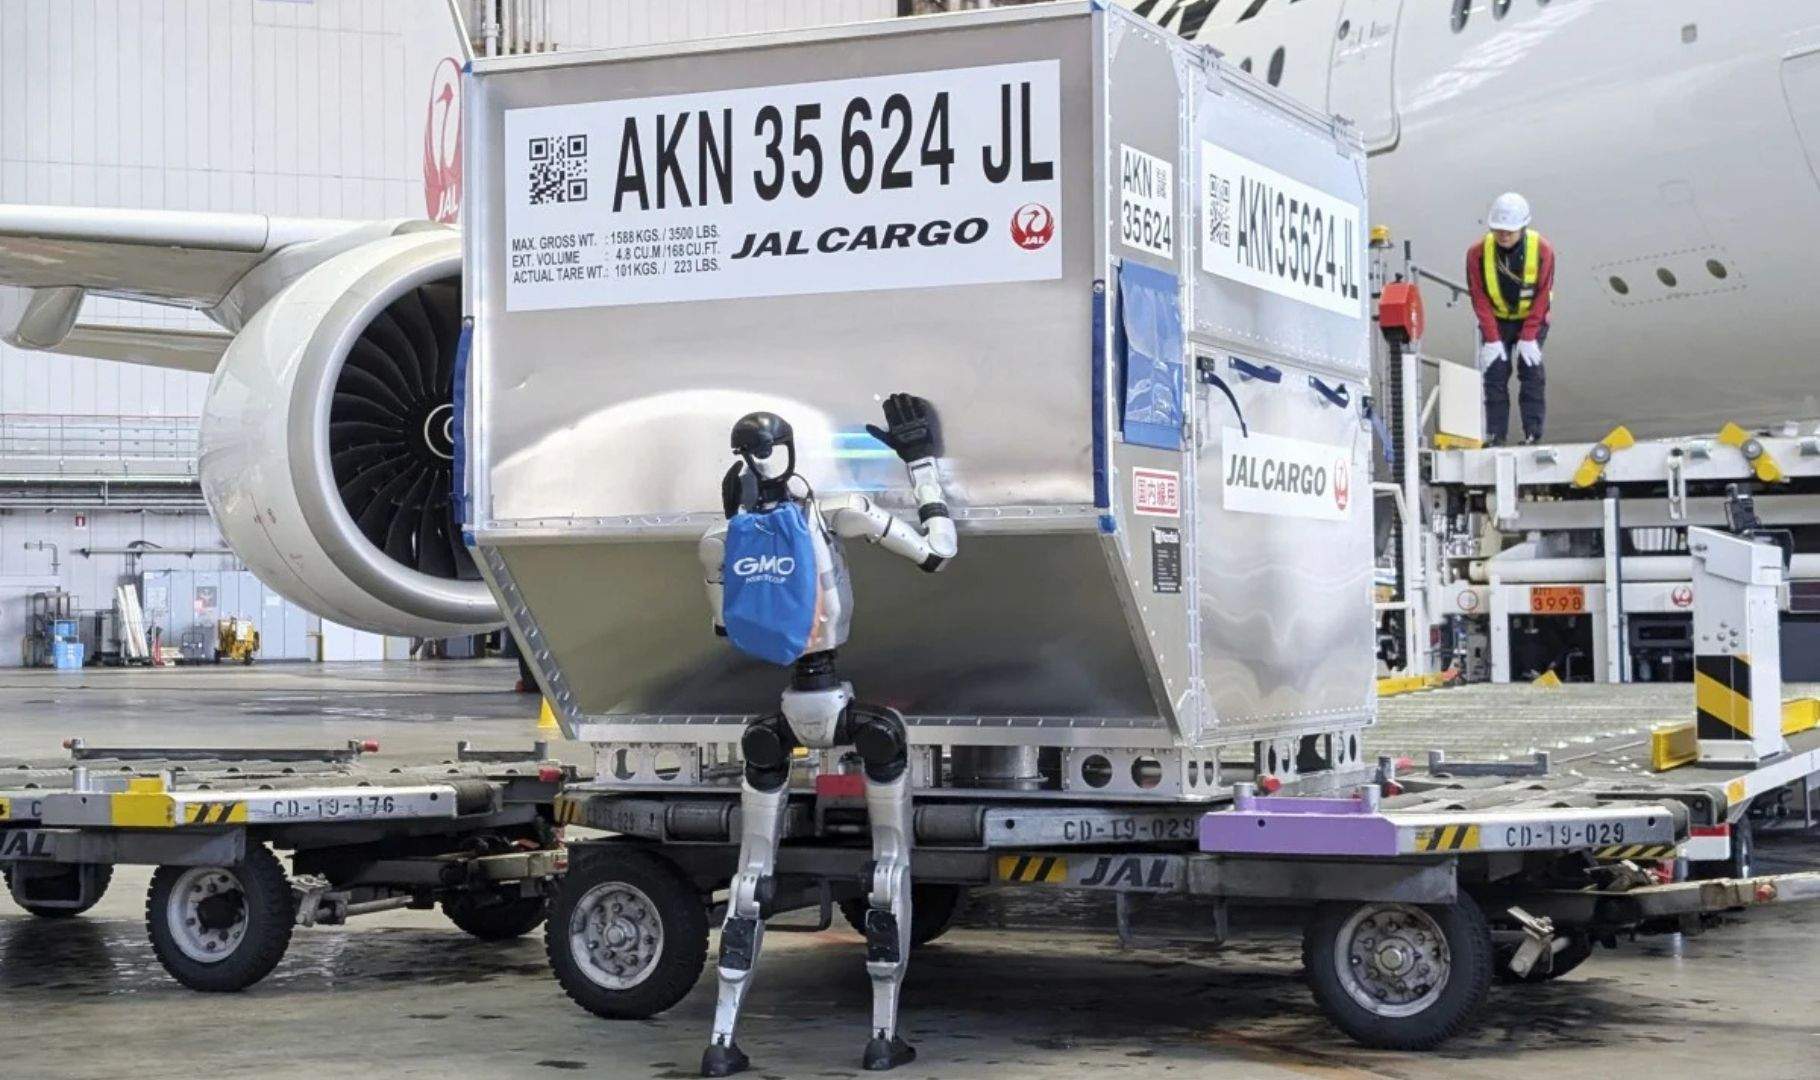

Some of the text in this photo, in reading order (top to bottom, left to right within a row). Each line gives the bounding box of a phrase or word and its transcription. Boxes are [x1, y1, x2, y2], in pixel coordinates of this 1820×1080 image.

[612, 108, 733, 212] AKN
[982, 82, 1053, 183] JL
[1123, 150, 1152, 199] AKN
[436, 184, 459, 222] JAL
[540, 235, 575, 249] GROSS
[696, 225, 720, 239] LBS.
[731, 217, 989, 259] JAL CARGO
[1123, 200, 1171, 252] 35624
[1022, 235, 1046, 245] JAL
[514, 269, 554, 283] ACTUAL
[557, 266, 585, 280] TARE
[674, 260, 692, 274] 223
[696, 258, 720, 272] LBS.
[537, 251, 580, 266] VOLUME
[733, 555, 795, 575] GMO
[1533, 596, 1581, 611] 3998
[273, 796, 394, 817] CD-19-176
[1064, 817, 1195, 841] CD-19-029
[1506, 823, 1624, 847] CD-19-029
[1080, 858, 1174, 888] JAL
